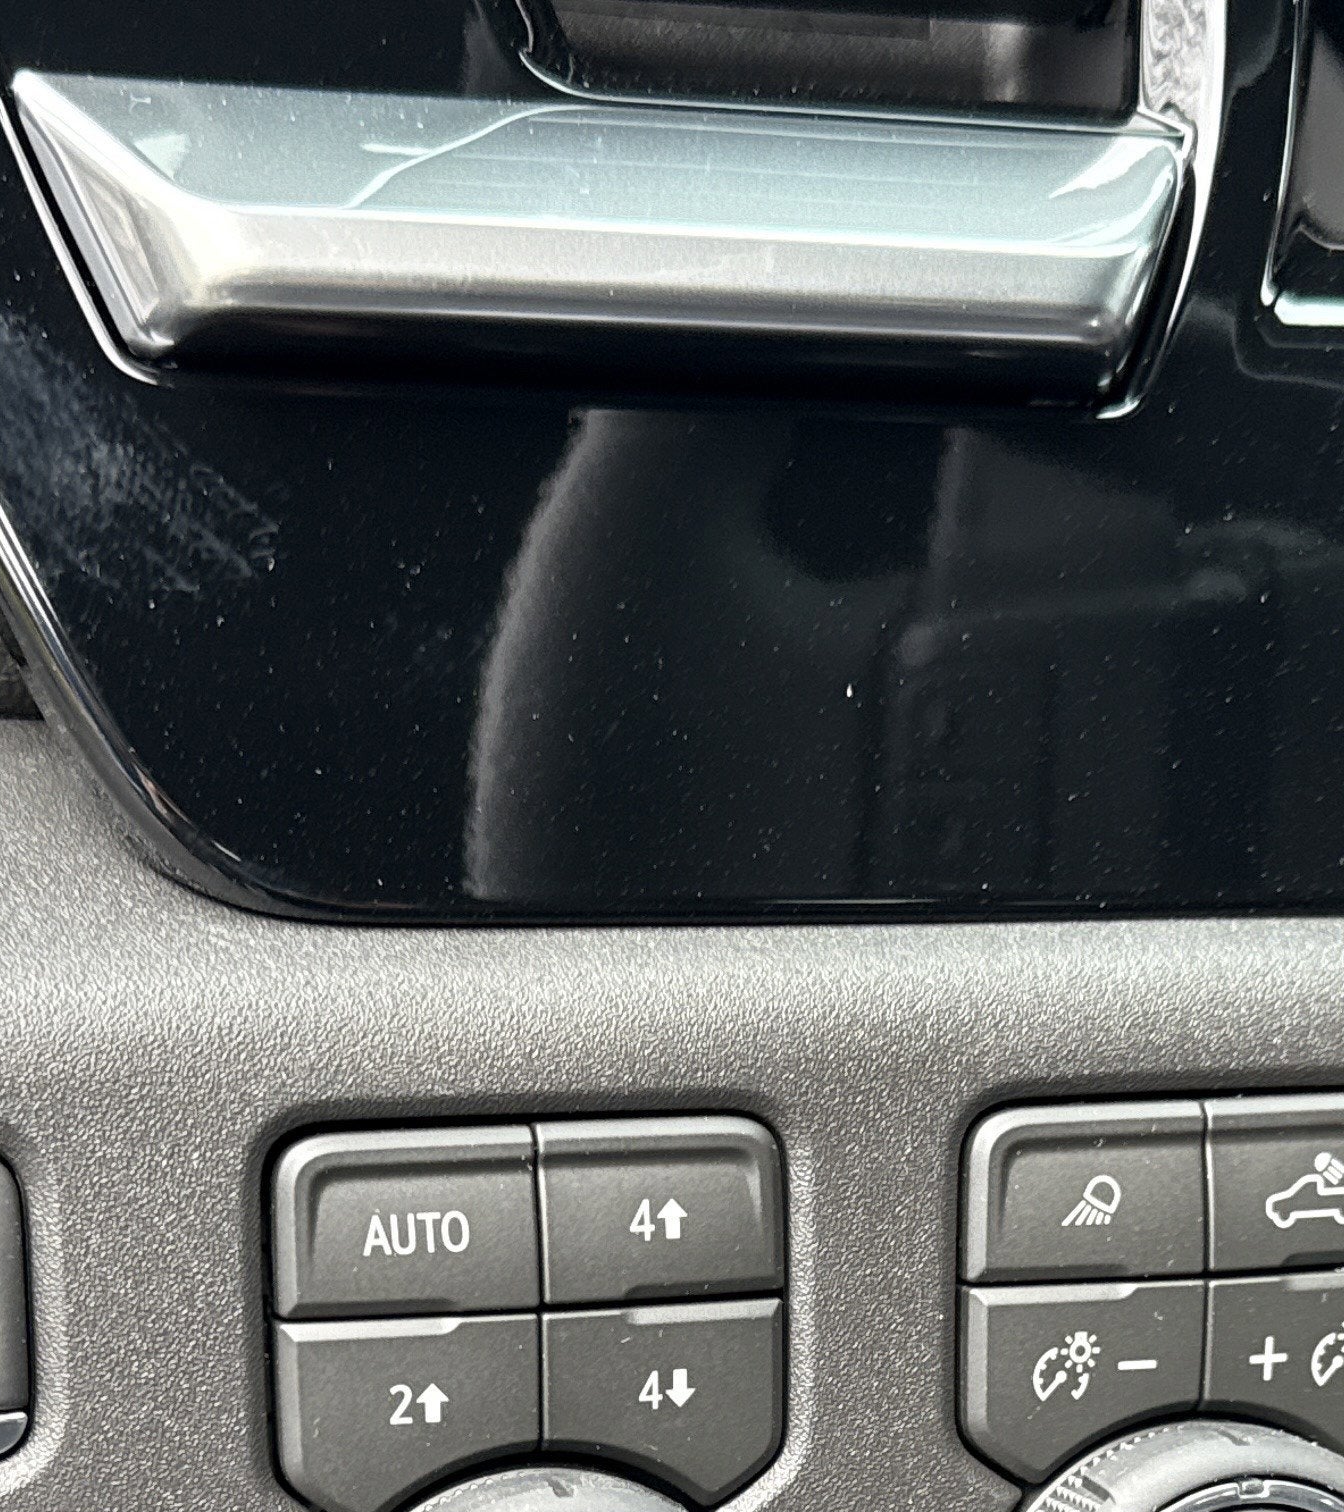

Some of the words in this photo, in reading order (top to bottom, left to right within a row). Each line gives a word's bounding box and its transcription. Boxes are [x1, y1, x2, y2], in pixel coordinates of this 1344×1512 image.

[362, 1210, 470, 1257] AUTO
[628, 1197, 656, 1242] 4
[389, 1384, 414, 1426] 2
[638, 1369, 664, 1410] 4
